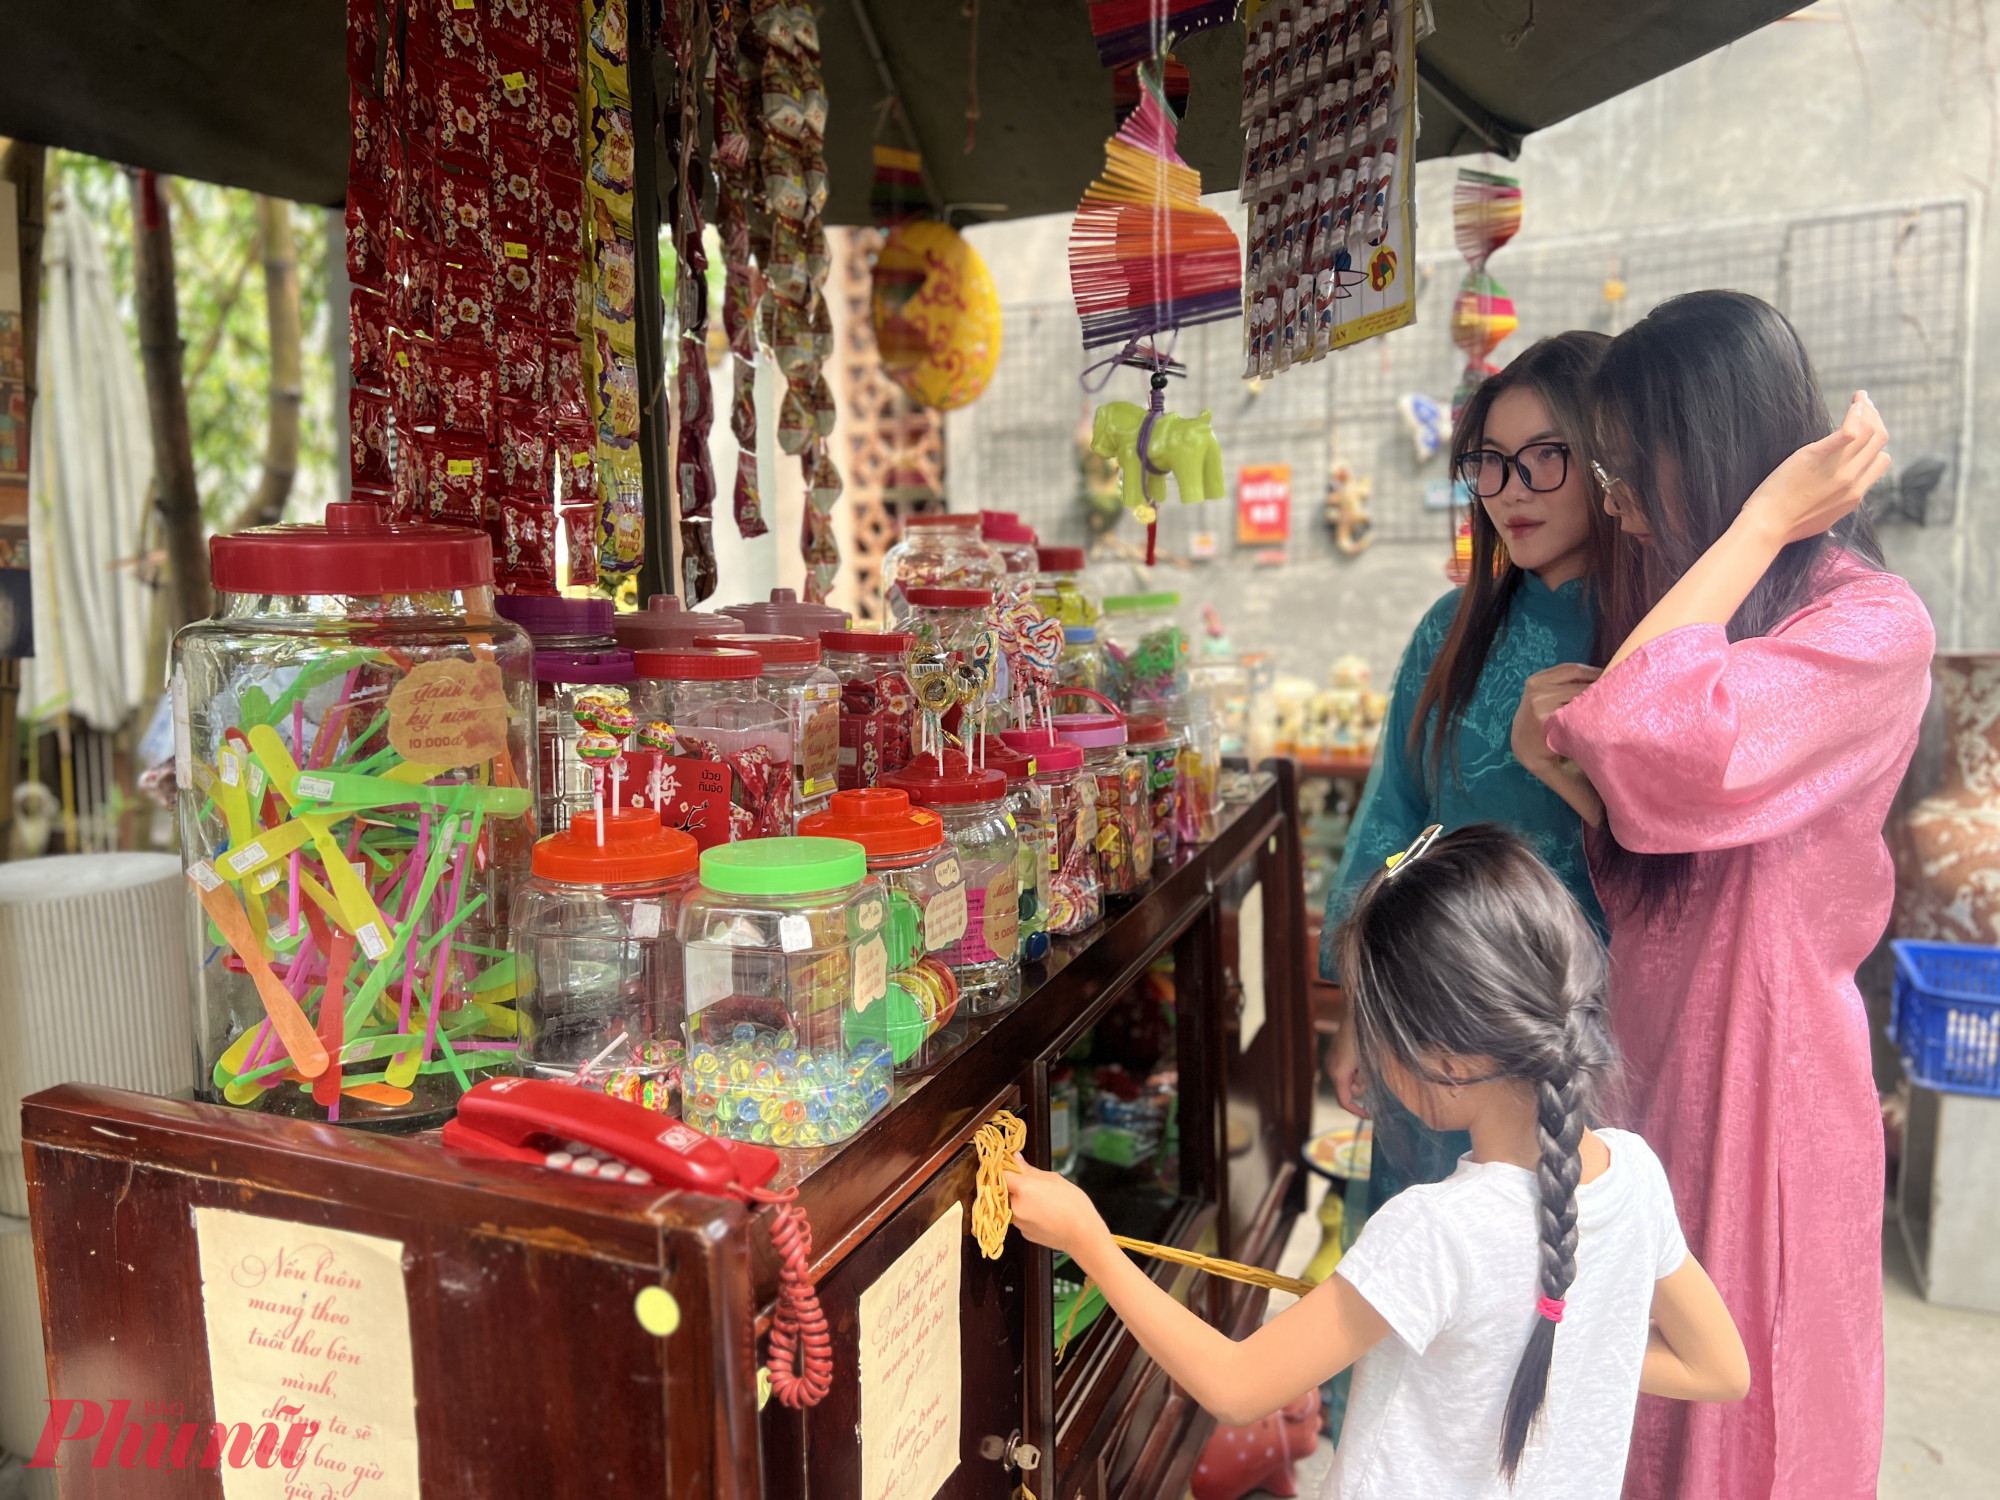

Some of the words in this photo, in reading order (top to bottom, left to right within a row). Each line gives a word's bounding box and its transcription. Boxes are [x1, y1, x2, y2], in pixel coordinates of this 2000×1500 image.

[314, 1251, 362, 1290] luôn
[248, 1297, 305, 1340] mang
[311, 1295, 351, 1326] theo
[248, 1327, 286, 1351] tuổi
[291, 1329, 322, 1358] thơ
[327, 1336, 361, 1366] bên
[281, 1370, 337, 1400] mình,
[328, 1415, 349, 1436] ta
[352, 1425, 373, 1442] sẽ
[314, 1443, 347, 1473] bao
[342, 1461, 385, 1498] giờ
